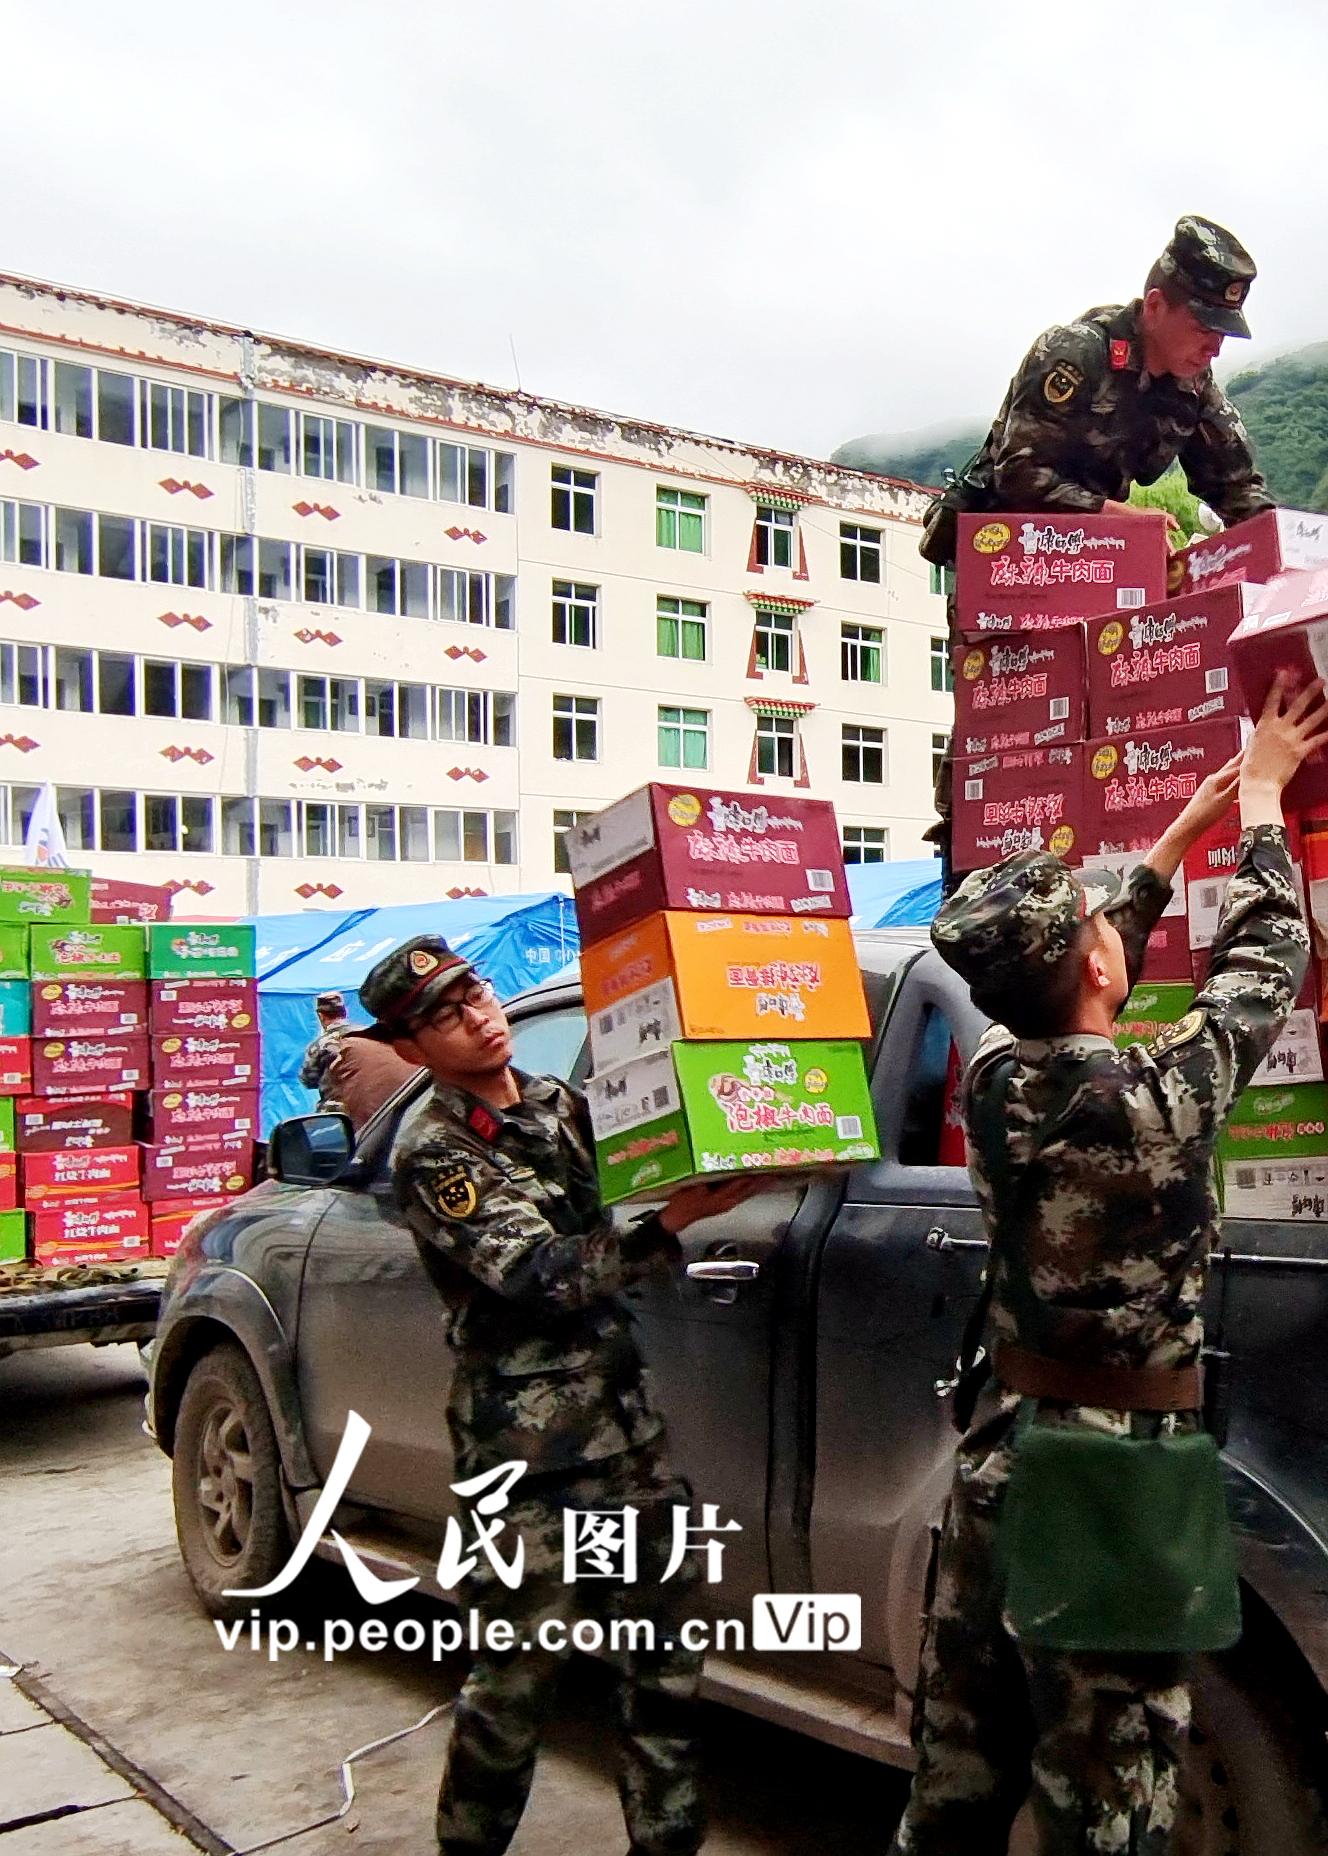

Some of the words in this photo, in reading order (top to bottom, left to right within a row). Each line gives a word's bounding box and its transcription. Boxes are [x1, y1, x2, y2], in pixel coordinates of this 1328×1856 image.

[991, 556, 1115, 587] 麻辣牛肉面
[1110, 642, 1201, 688] 麻辣牛肉面
[1105, 773, 1197, 812] 麻辣牛肉面
